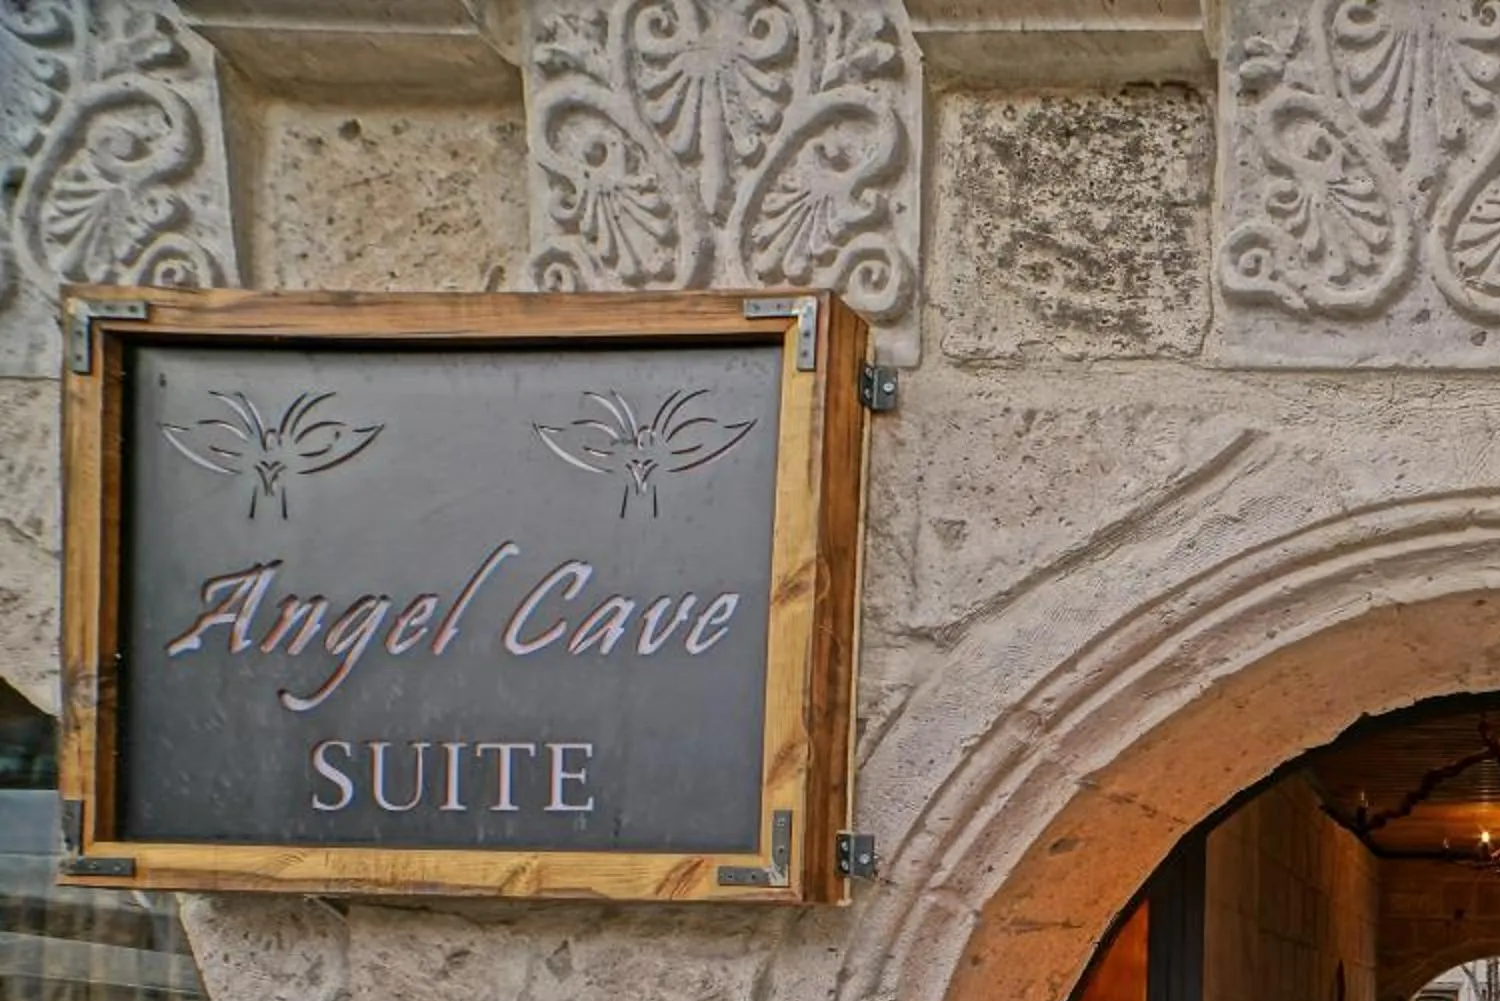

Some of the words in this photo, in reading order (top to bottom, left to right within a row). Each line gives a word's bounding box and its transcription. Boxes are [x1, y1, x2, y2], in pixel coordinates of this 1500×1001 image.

[166, 540, 520, 713] Angel
[503, 559, 740, 657] Cave
[311, 740, 596, 813] SUITE
